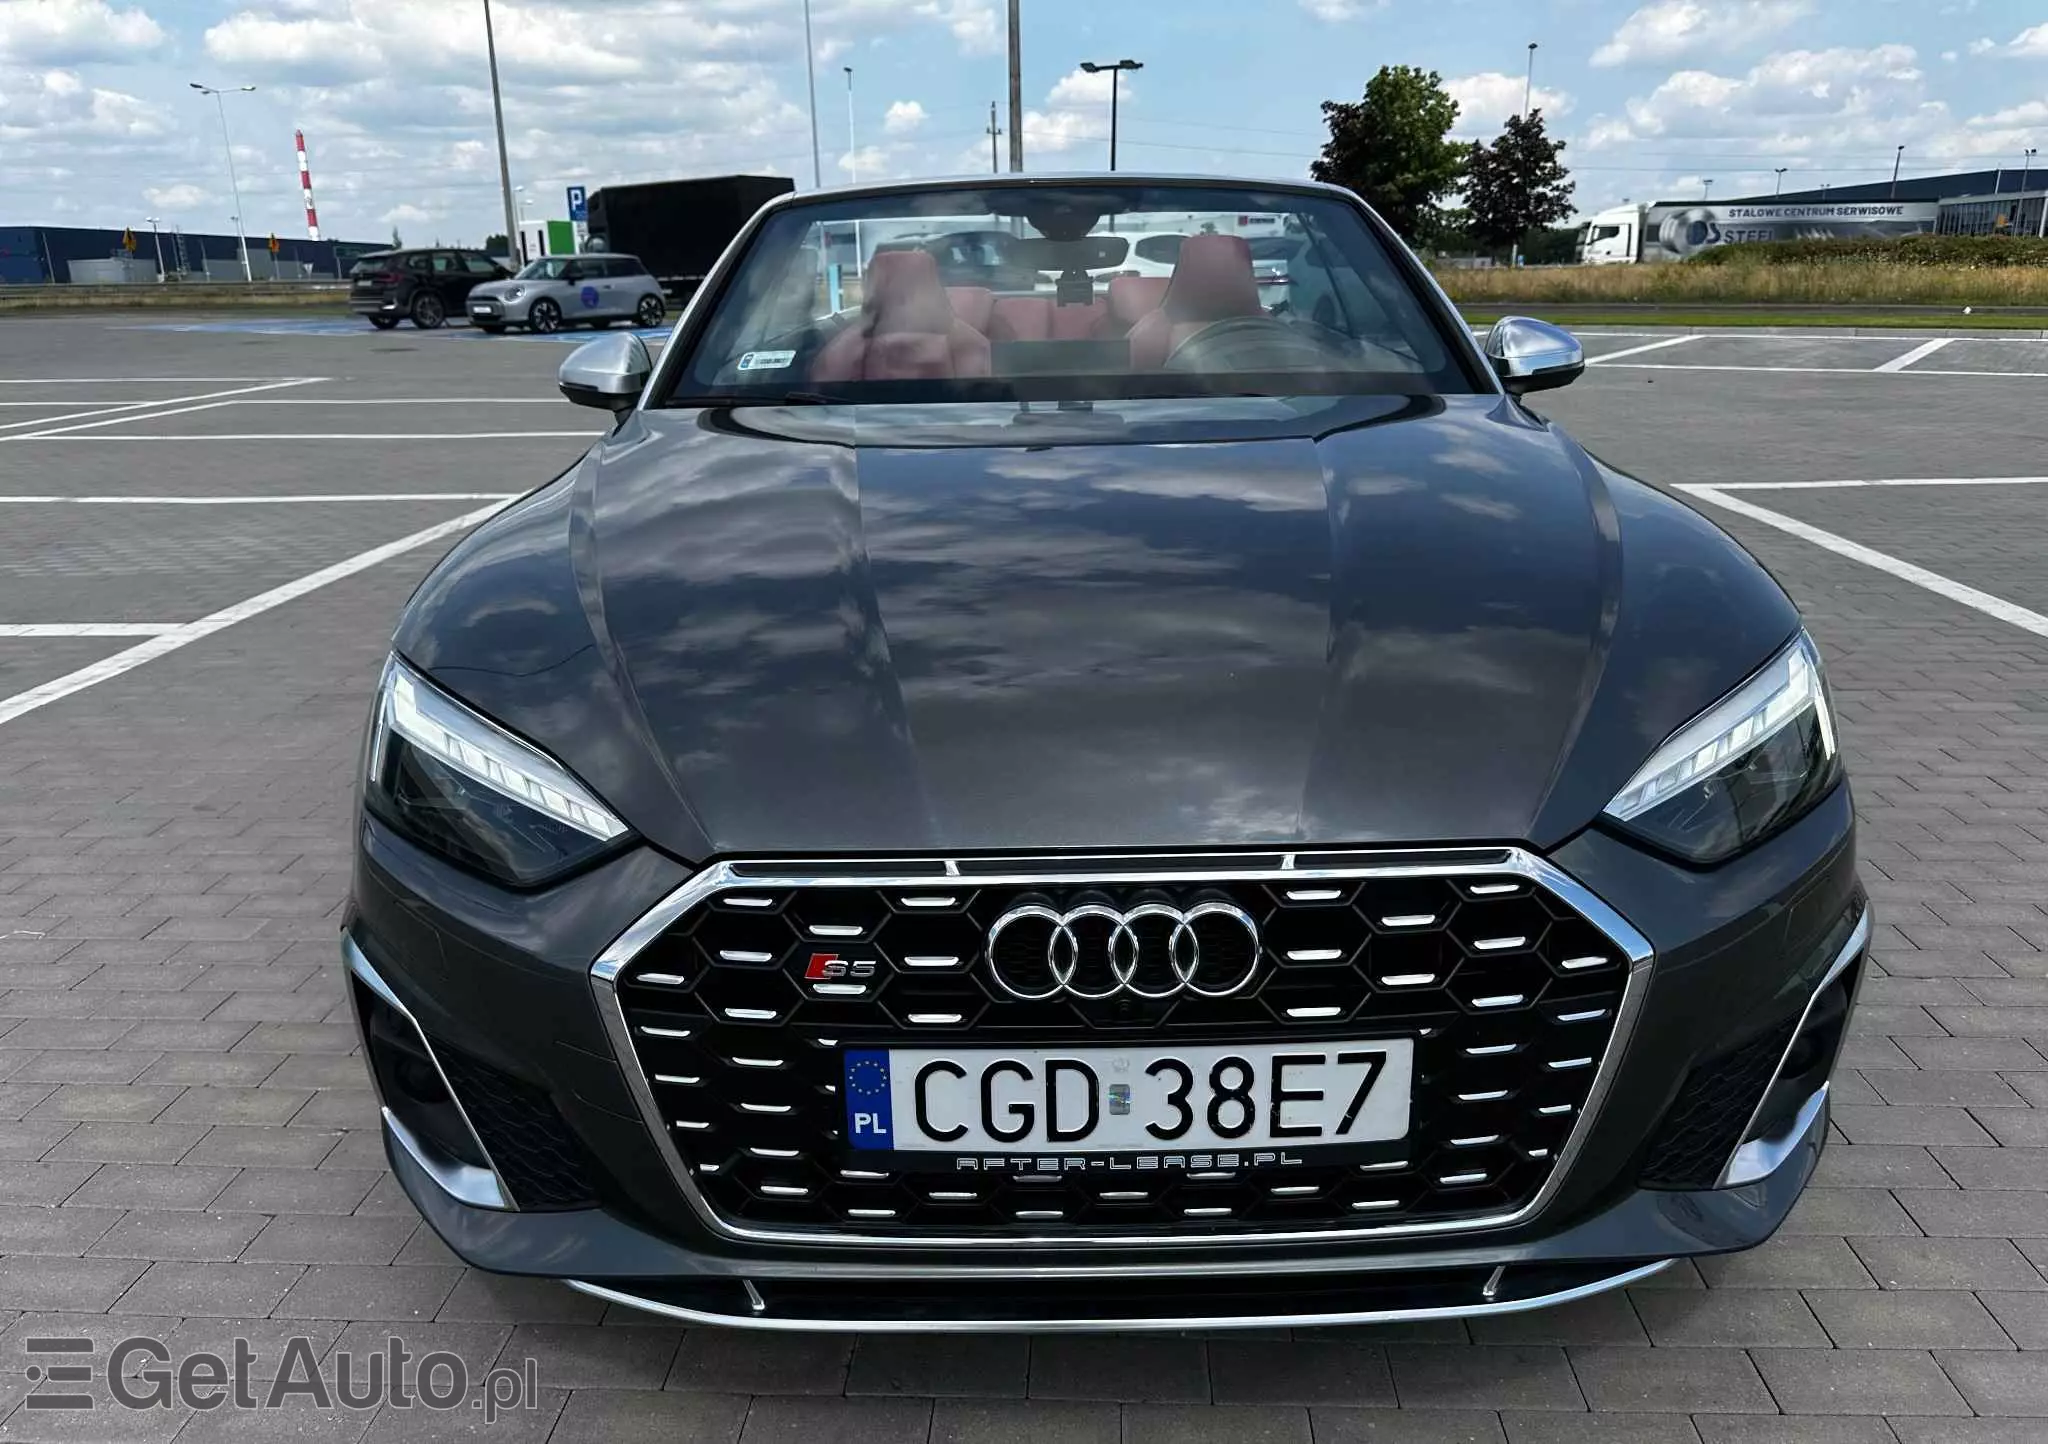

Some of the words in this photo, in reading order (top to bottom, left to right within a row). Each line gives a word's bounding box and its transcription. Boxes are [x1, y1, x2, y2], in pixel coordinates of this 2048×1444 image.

[1728, 208, 1782, 218] STALOWE
[1784, 207, 1835, 217] CENTRUM
[1836, 206, 1904, 216] SERWISOWE
[822, 960, 876, 977] S5
[913, 1058, 1099, 1142] CGD
[1144, 1051, 1388, 1141] 38E7
[855, 1113, 887, 1134] PL
[956, 1152, 1302, 1170] AFTER-LEASE.PL
